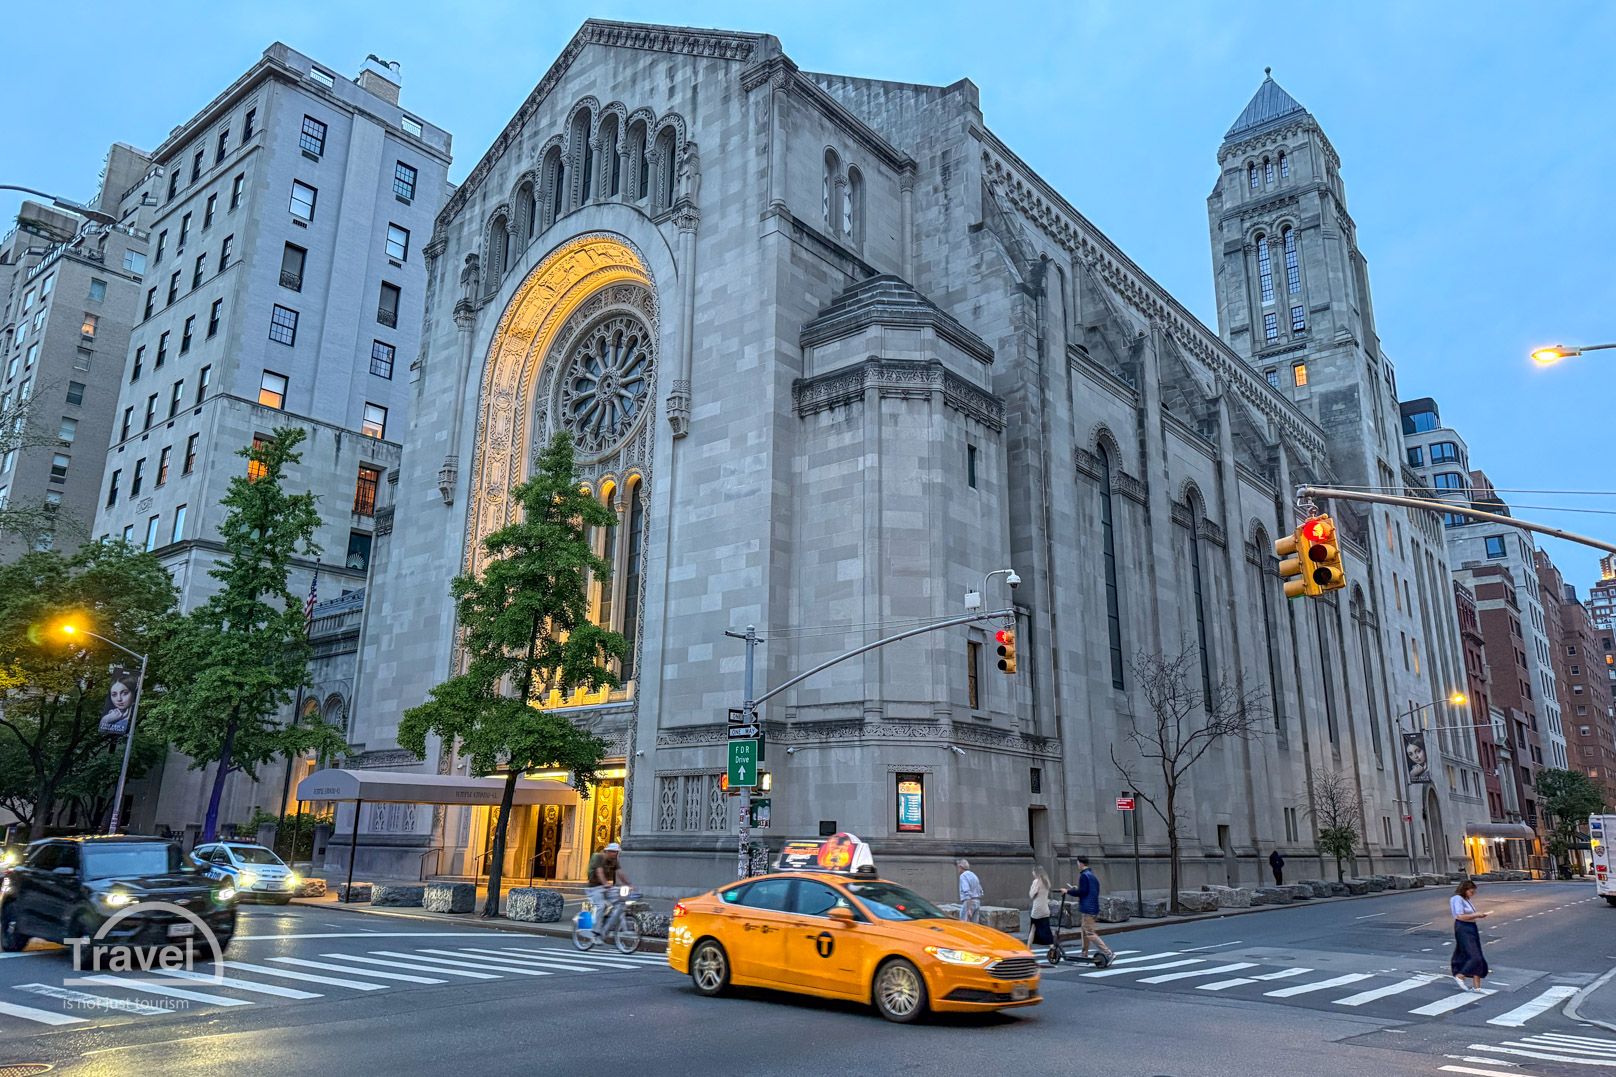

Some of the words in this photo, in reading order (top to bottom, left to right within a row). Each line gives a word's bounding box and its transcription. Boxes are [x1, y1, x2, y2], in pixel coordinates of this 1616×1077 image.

[732, 728, 742, 736] ONE
[744, 727, 756, 735] WAY
[735, 745, 750, 754] FDR
[735, 755, 750, 764] Drive
